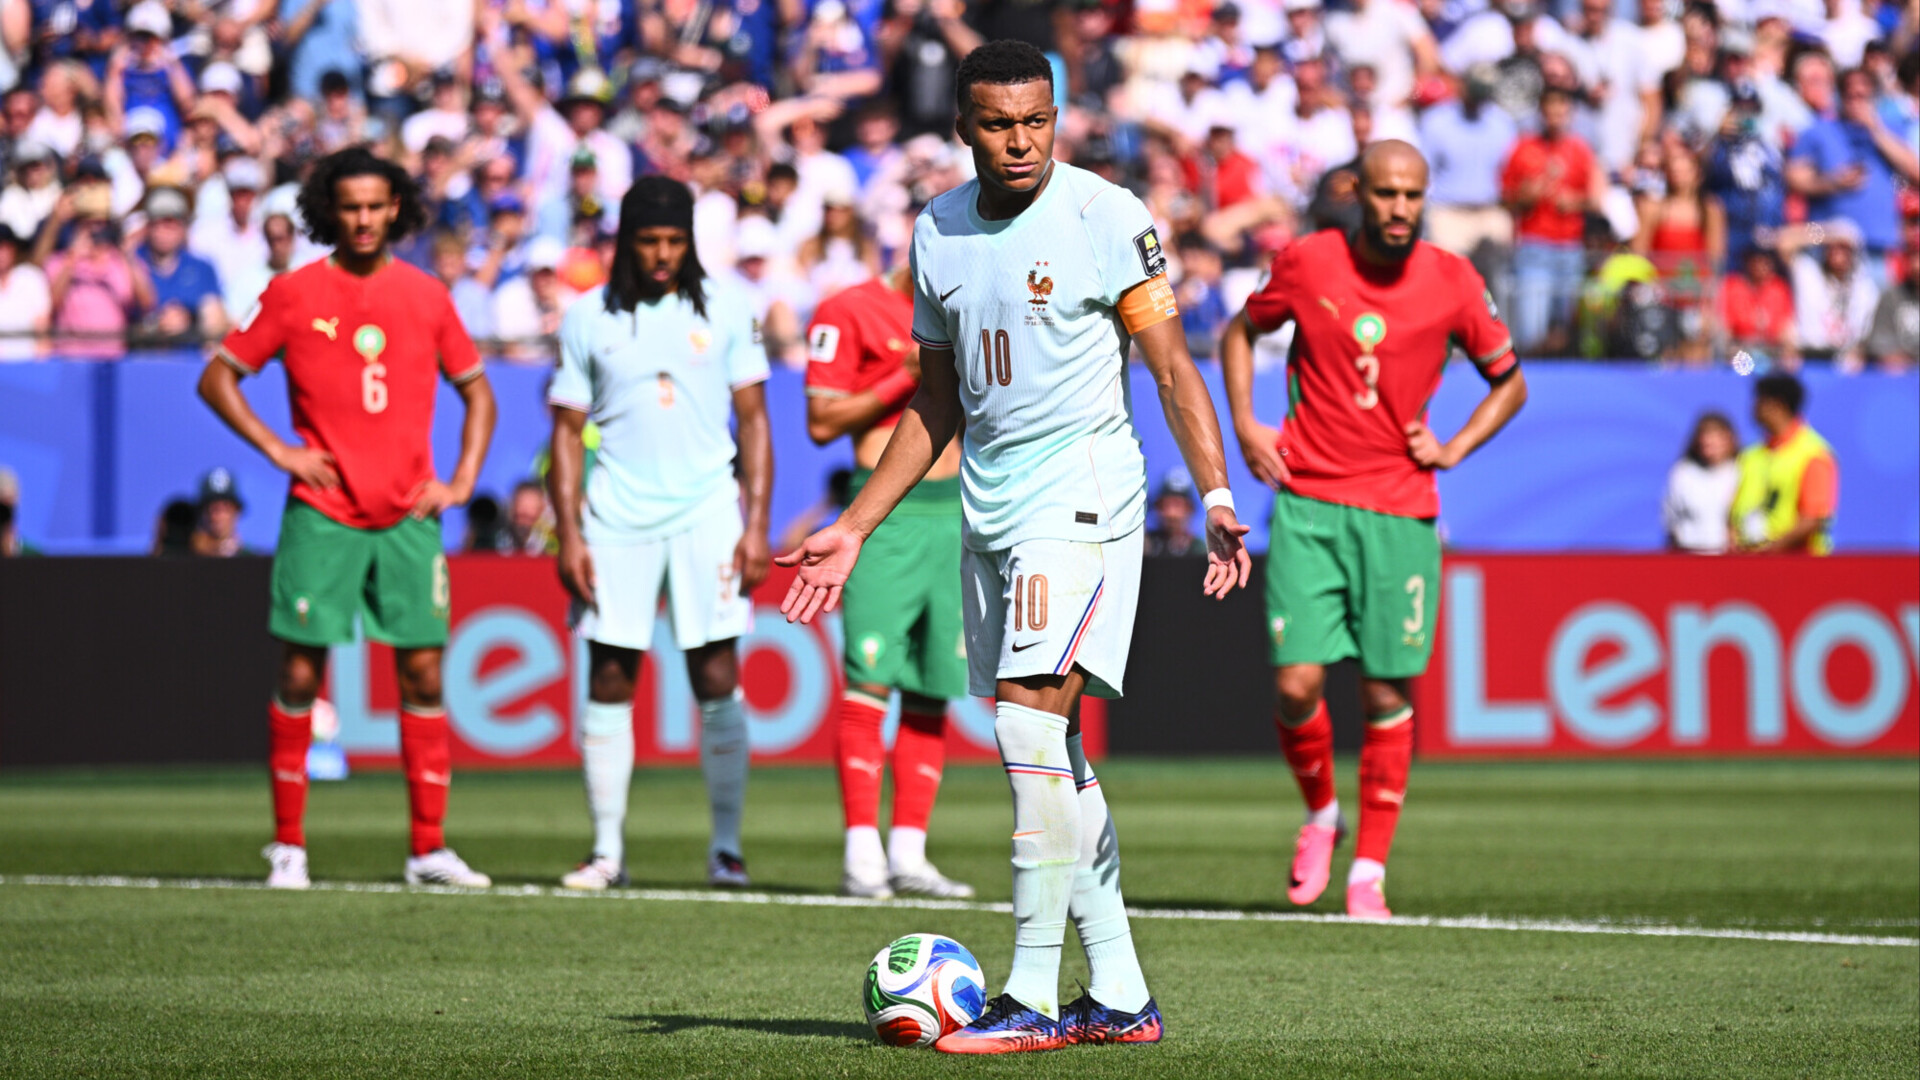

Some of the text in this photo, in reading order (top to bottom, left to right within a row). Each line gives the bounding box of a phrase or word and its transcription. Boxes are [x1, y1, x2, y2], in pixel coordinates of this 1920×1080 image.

[981, 328, 1012, 386] 10
[1354, 354, 1380, 410] 3
[361, 362, 388, 414] 6
[1015, 574, 1049, 632] 10
[1402, 573, 1425, 633] 3
[1446, 564, 1919, 746] Leno
